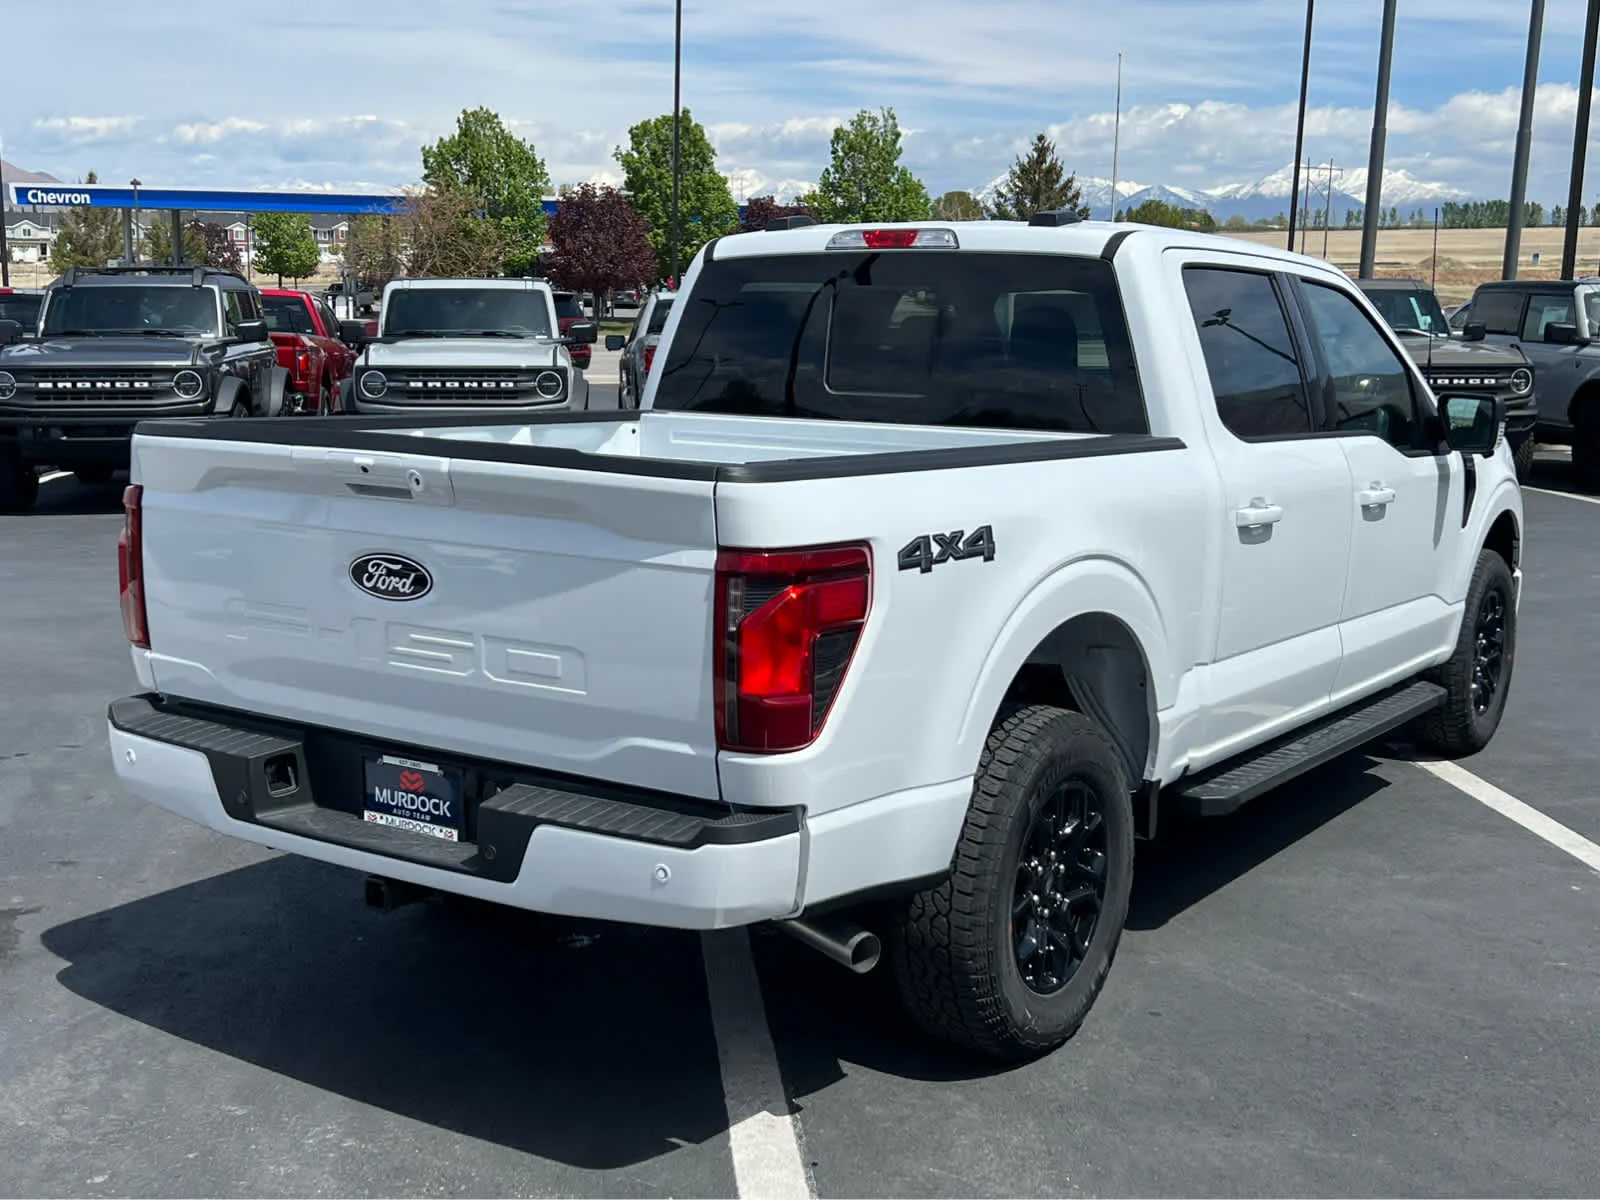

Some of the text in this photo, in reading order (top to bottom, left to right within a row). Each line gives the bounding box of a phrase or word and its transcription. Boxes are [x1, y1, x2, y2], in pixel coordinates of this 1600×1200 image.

[27, 189, 91, 204] Chevron
[362, 559, 416, 594] Ford
[375, 786, 451, 818] MURDOCK
